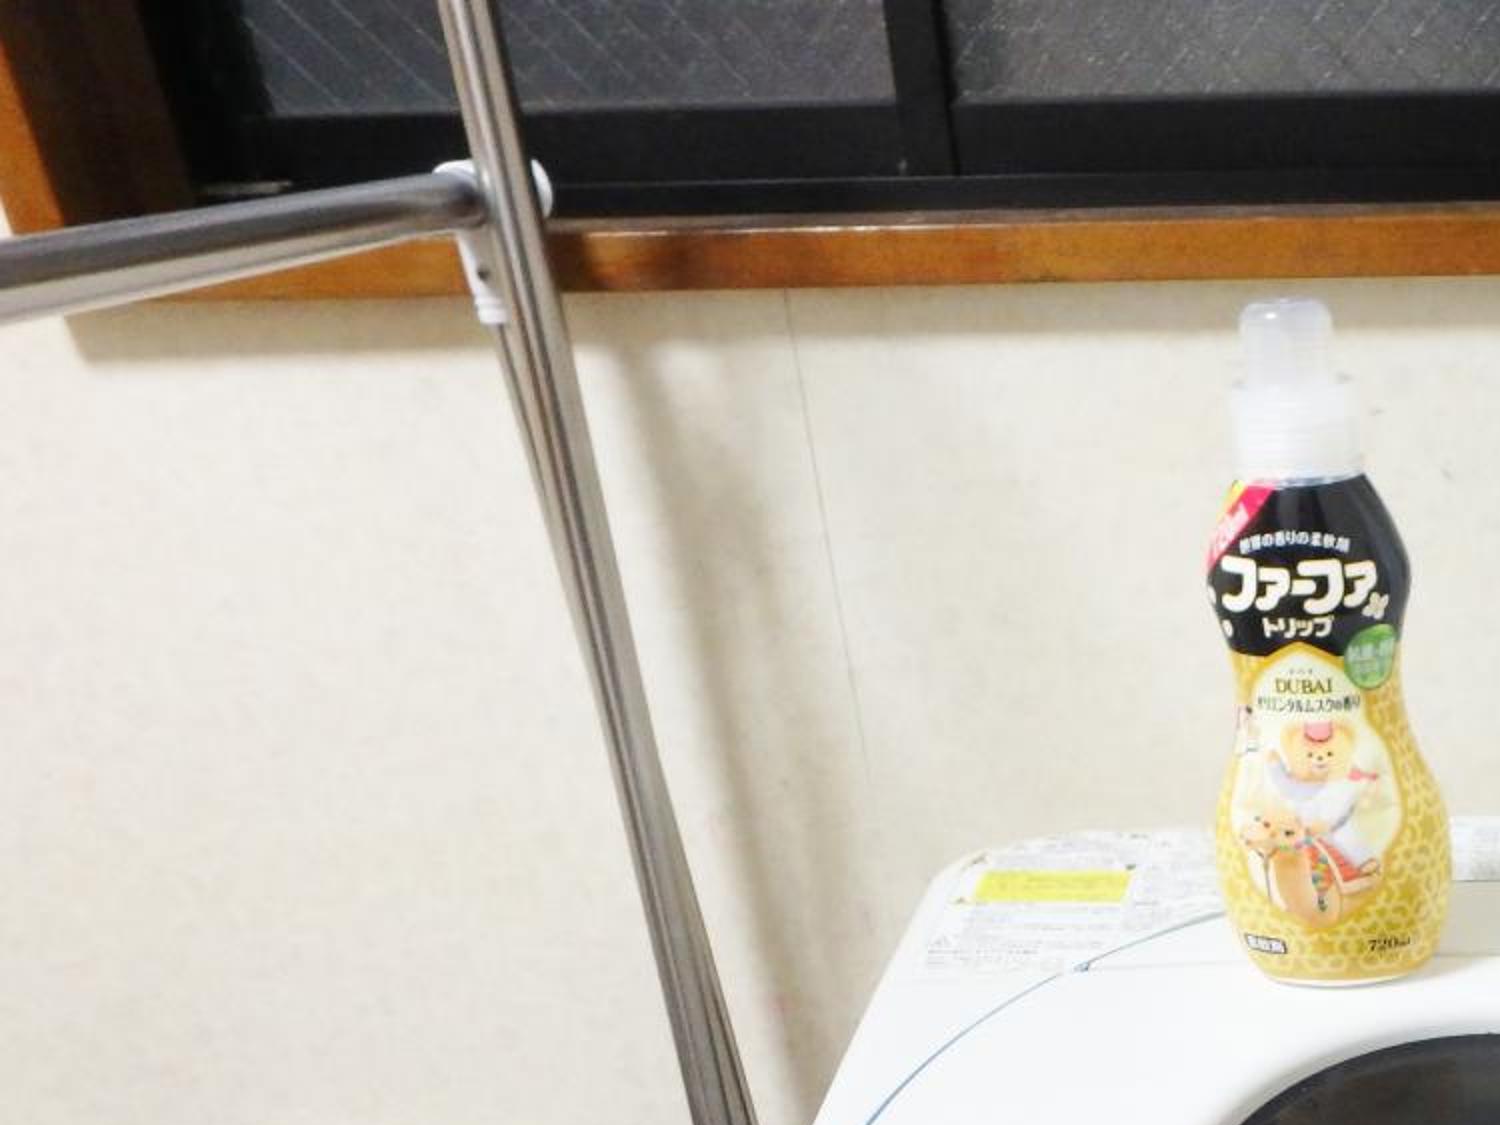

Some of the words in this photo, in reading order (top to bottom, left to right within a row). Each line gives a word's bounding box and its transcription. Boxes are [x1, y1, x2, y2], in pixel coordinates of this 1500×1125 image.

[1221, 555, 1377, 614] ファーファ
[1263, 615, 1334, 638] トリップ
[1275, 677, 1333, 695] DUBAI
